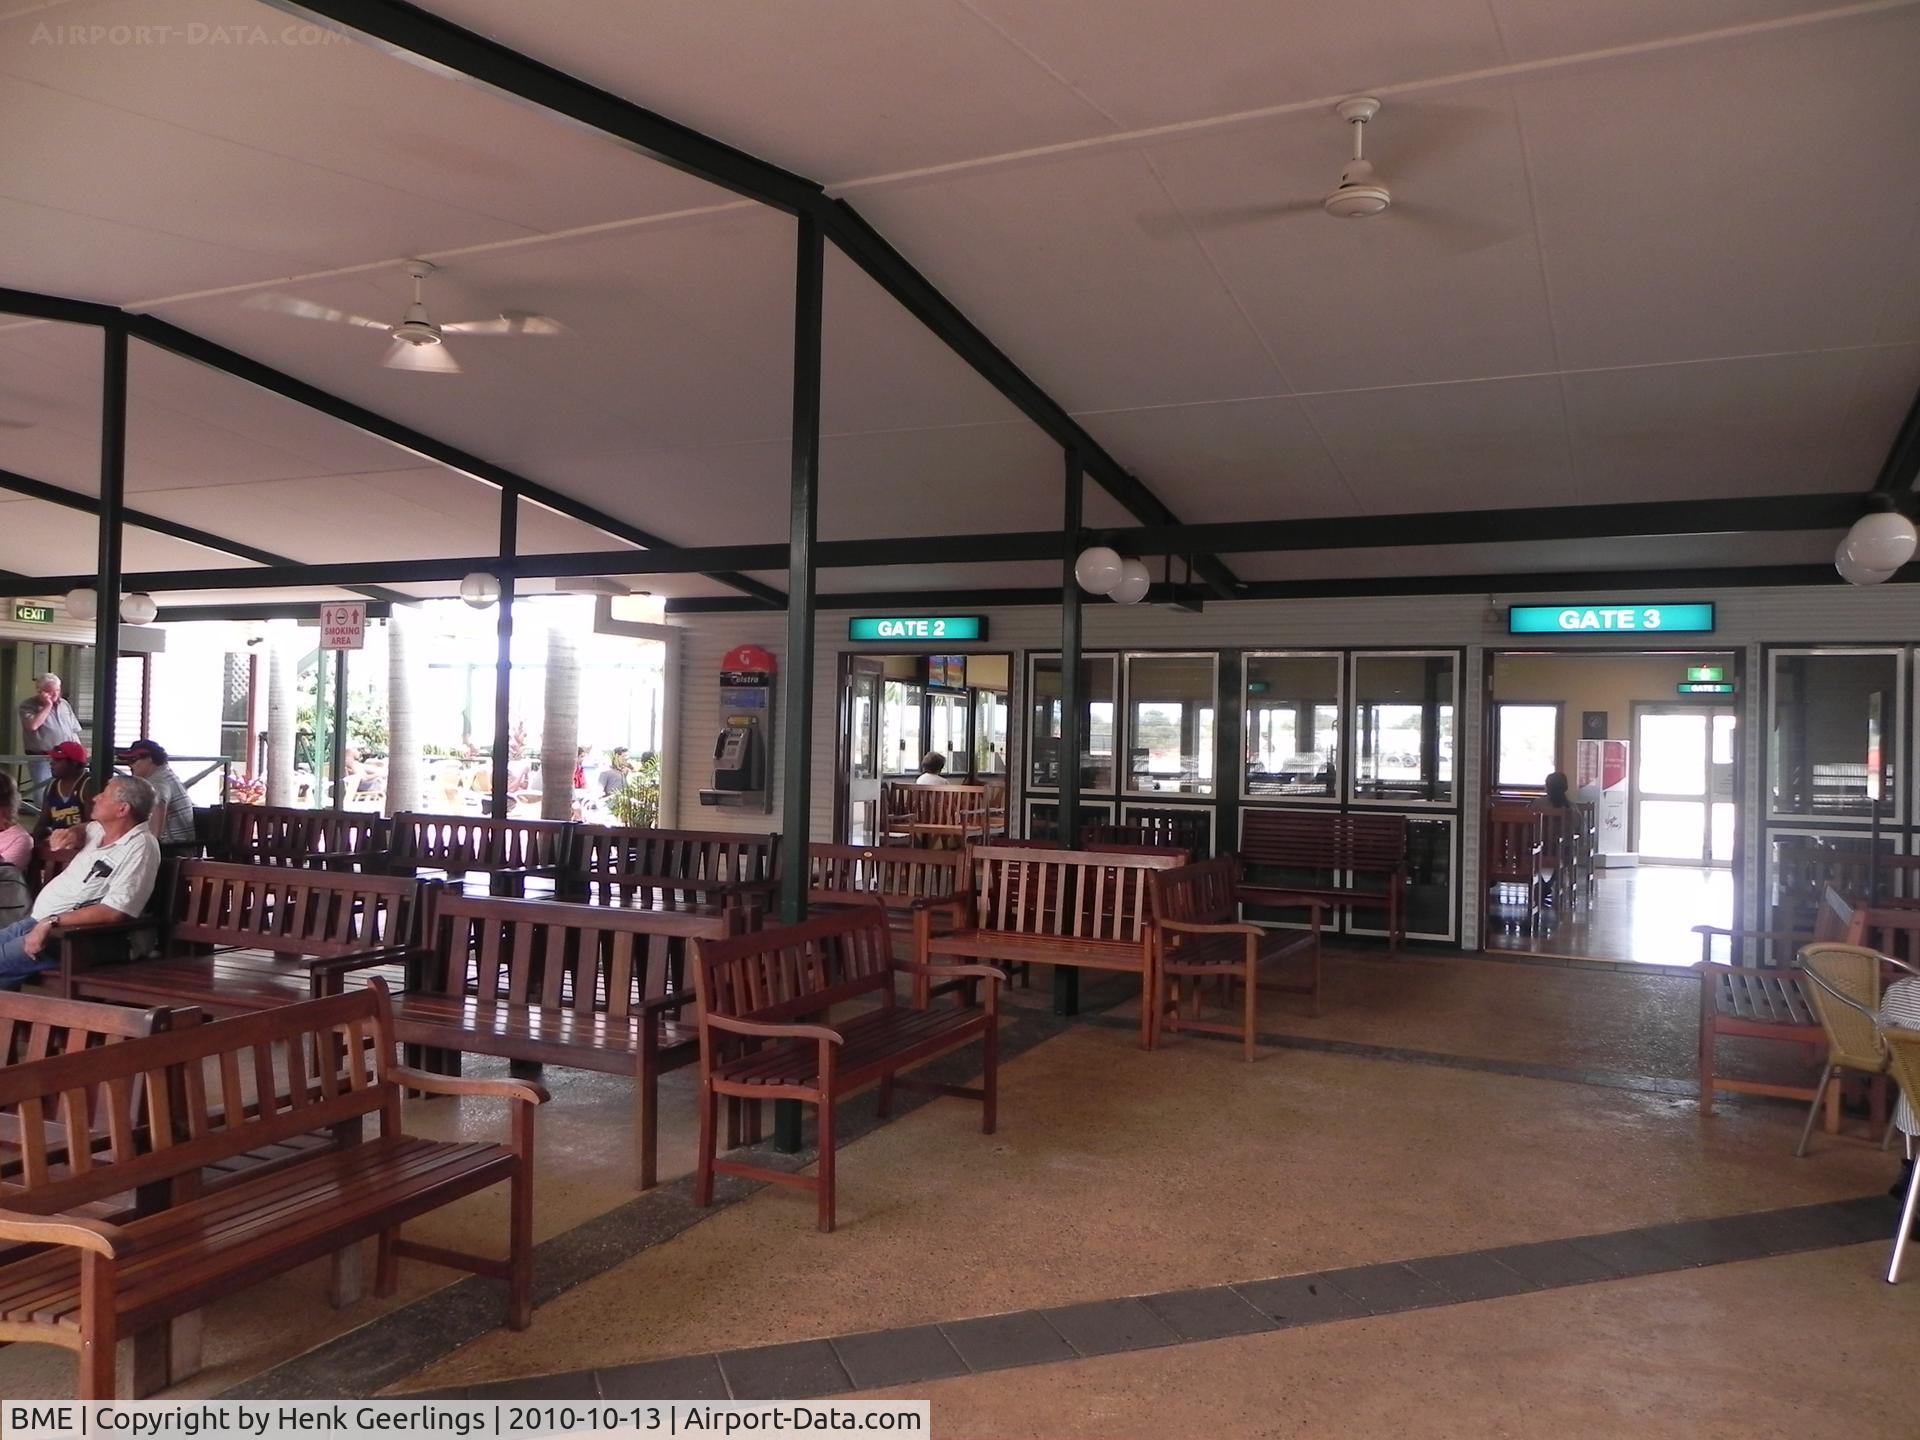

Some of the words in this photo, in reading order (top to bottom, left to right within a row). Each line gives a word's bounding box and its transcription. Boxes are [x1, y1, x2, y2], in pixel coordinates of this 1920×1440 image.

[23, 607, 46, 620] EXIT
[1558, 610, 1635, 629] GATE
[1643, 609, 1661, 628] 3
[324, 626, 360, 635] SMOKING
[877, 620, 928, 636] GATE
[933, 619, 945, 636] 2
[331, 636, 351, 645] AREA
[1690, 684, 1714, 692] GATE
[1714, 684, 1721, 692] 3
